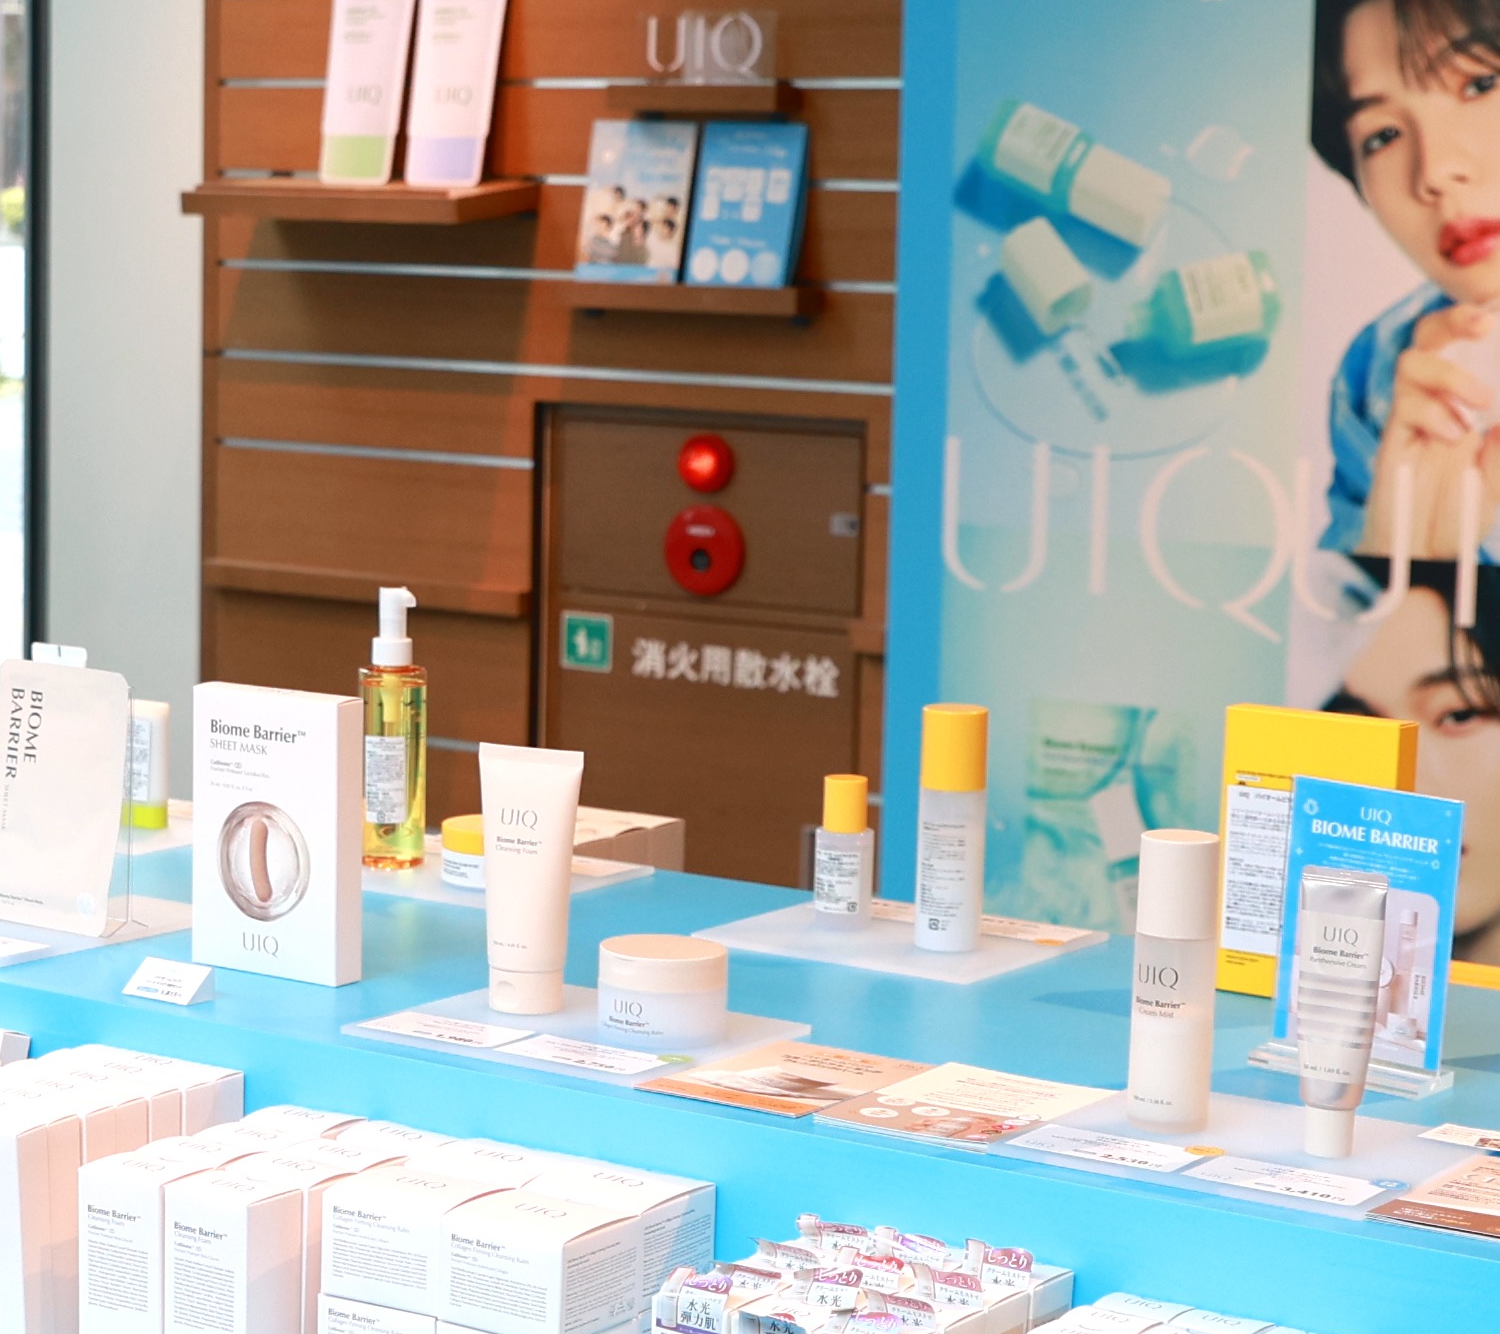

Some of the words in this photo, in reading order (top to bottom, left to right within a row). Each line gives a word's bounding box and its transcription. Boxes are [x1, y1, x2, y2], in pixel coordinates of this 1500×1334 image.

[645, 11, 763, 86] UIQ
[941, 436, 1292, 644] UIQ
[632, 638, 840, 698] 消火用散水栓
[5, 687, 26, 781] BARRIER
[23, 689, 44, 765] BIOME
[210, 717, 250, 739] Biome
[209, 738, 237, 752] SHEET
[239, 742, 268, 756] MASK
[500, 807, 538, 832] UIQ
[1360, 806, 1392, 826] UIQ
[496, 835, 516, 845] Biome
[1311, 818, 1366, 842] BIOME
[1370, 827, 1438, 855] BARRIER
[241, 930, 279, 959] UIQ
[1323, 925, 1359, 947] UIQ
[1313, 945, 1337, 957] Biome
[1138, 963, 1179, 991] UIQ
[613, 998, 643, 1019] UIQ
[87, 1203, 110, 1217] Biome
[333, 1205, 356, 1219] Biome
[173, 1220, 197, 1235] Biome
[451, 1233, 474, 1246] Biome
